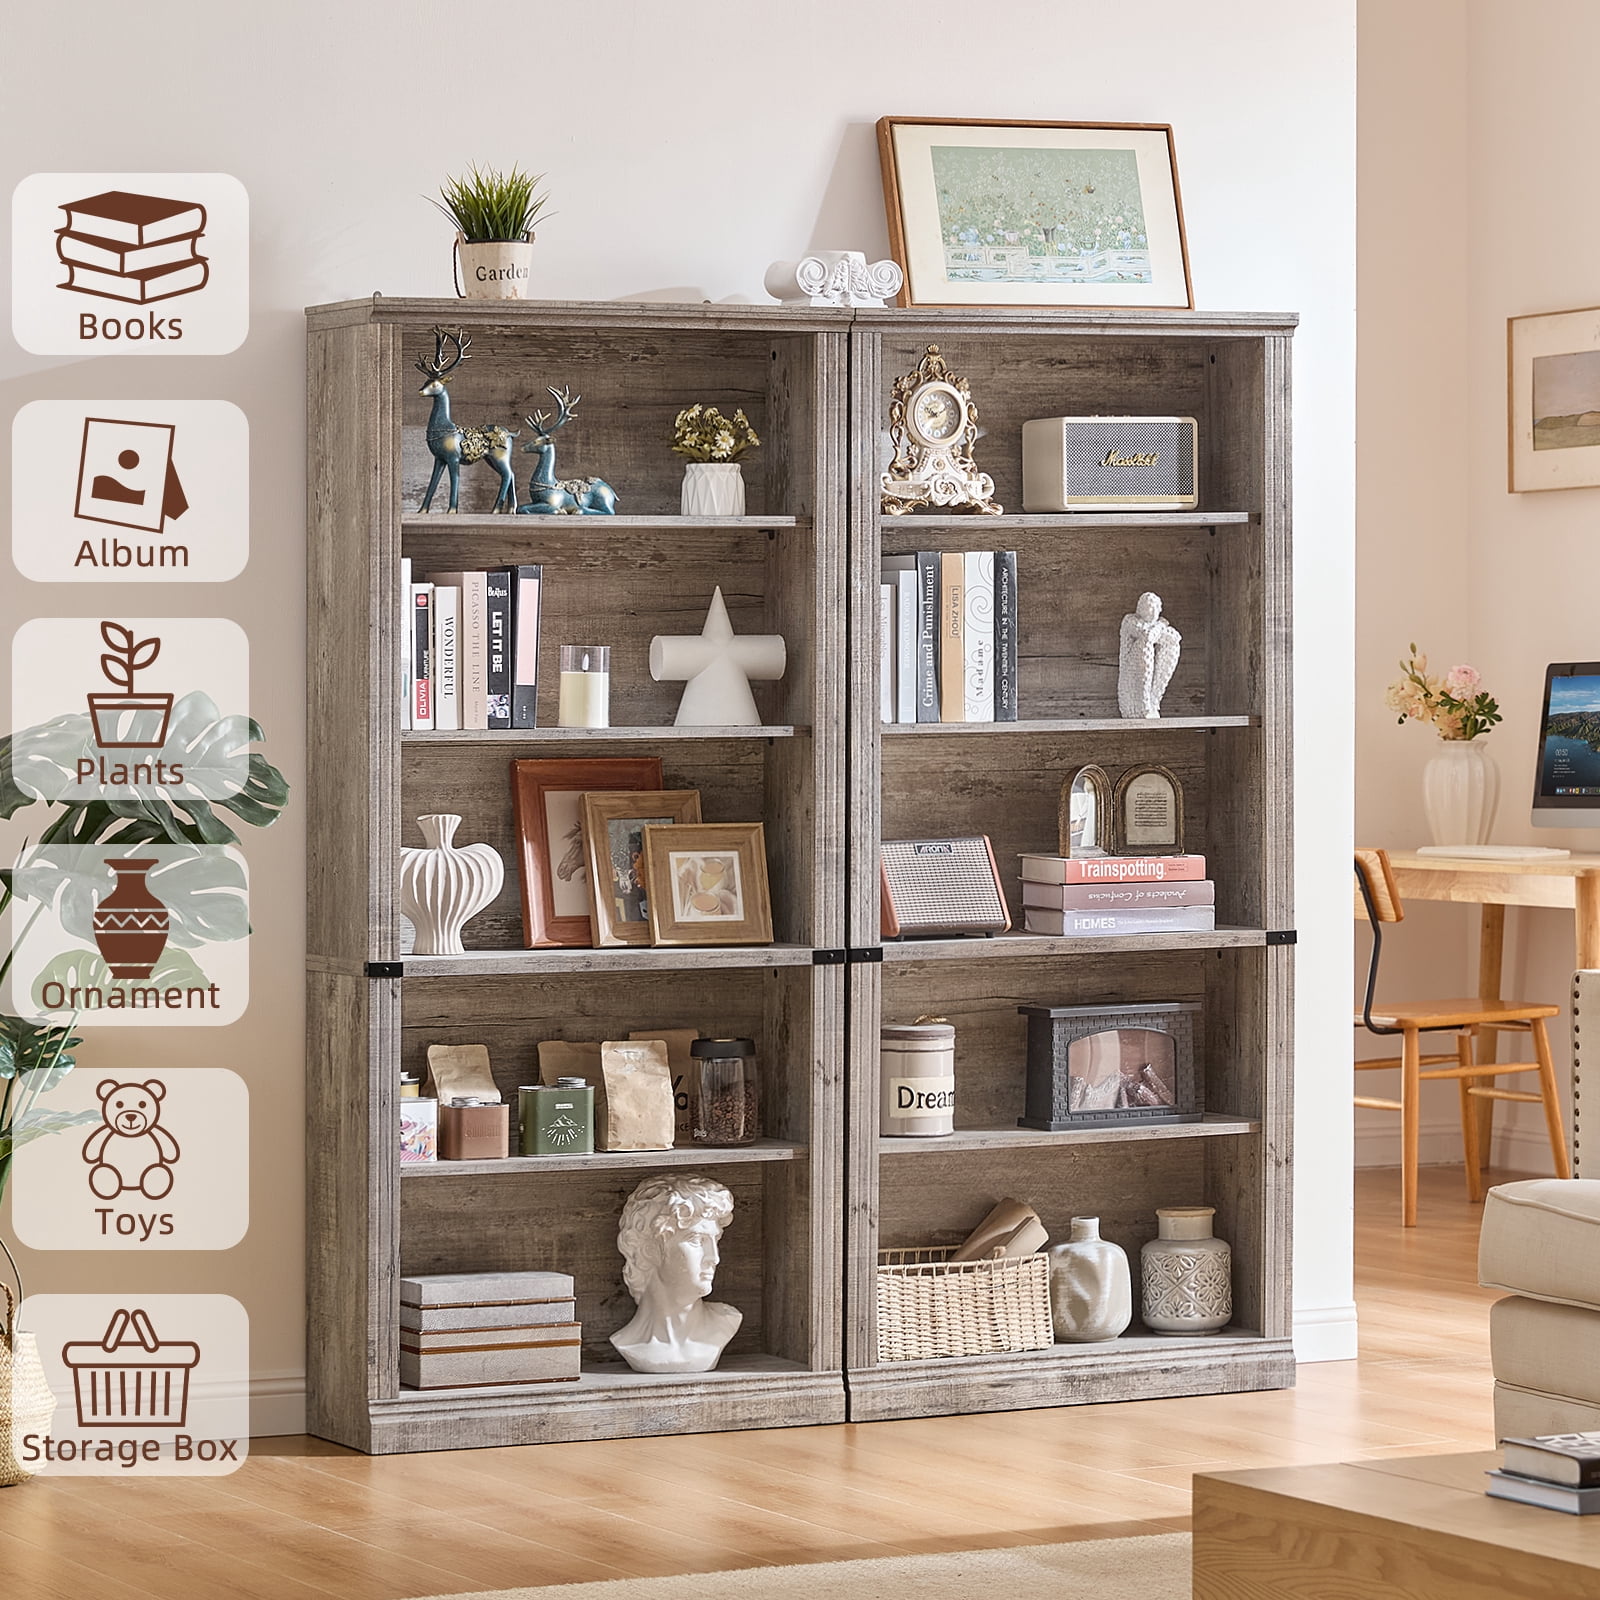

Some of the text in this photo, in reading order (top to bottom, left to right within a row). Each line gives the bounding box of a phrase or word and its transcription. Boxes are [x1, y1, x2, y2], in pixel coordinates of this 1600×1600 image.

[475, 263, 529, 282] Garden
[471, 581, 480, 630] PICASSO
[1001, 567, 1009, 615] ARCHITECTURE
[951, 587, 960, 636] LISA ZHOU
[471, 635, 480, 658] THE
[492, 611, 503, 673] LET IT BE
[922, 565, 935, 708] Crime and Punishment
[1001, 628, 1009, 640] THE
[443, 616, 454, 699] WONDERFUL
[975, 639, 984, 697] Madame
[1001, 643, 1009, 676] TWENTIETH
[471, 664, 480, 693] LINE
[1001, 679, 1009, 709] CENTURY
[418, 682, 427, 716] OLIVIA
[1088, 889, 1187, 902] Analects of Confucius
[1074, 917, 1116, 930] HOMES
